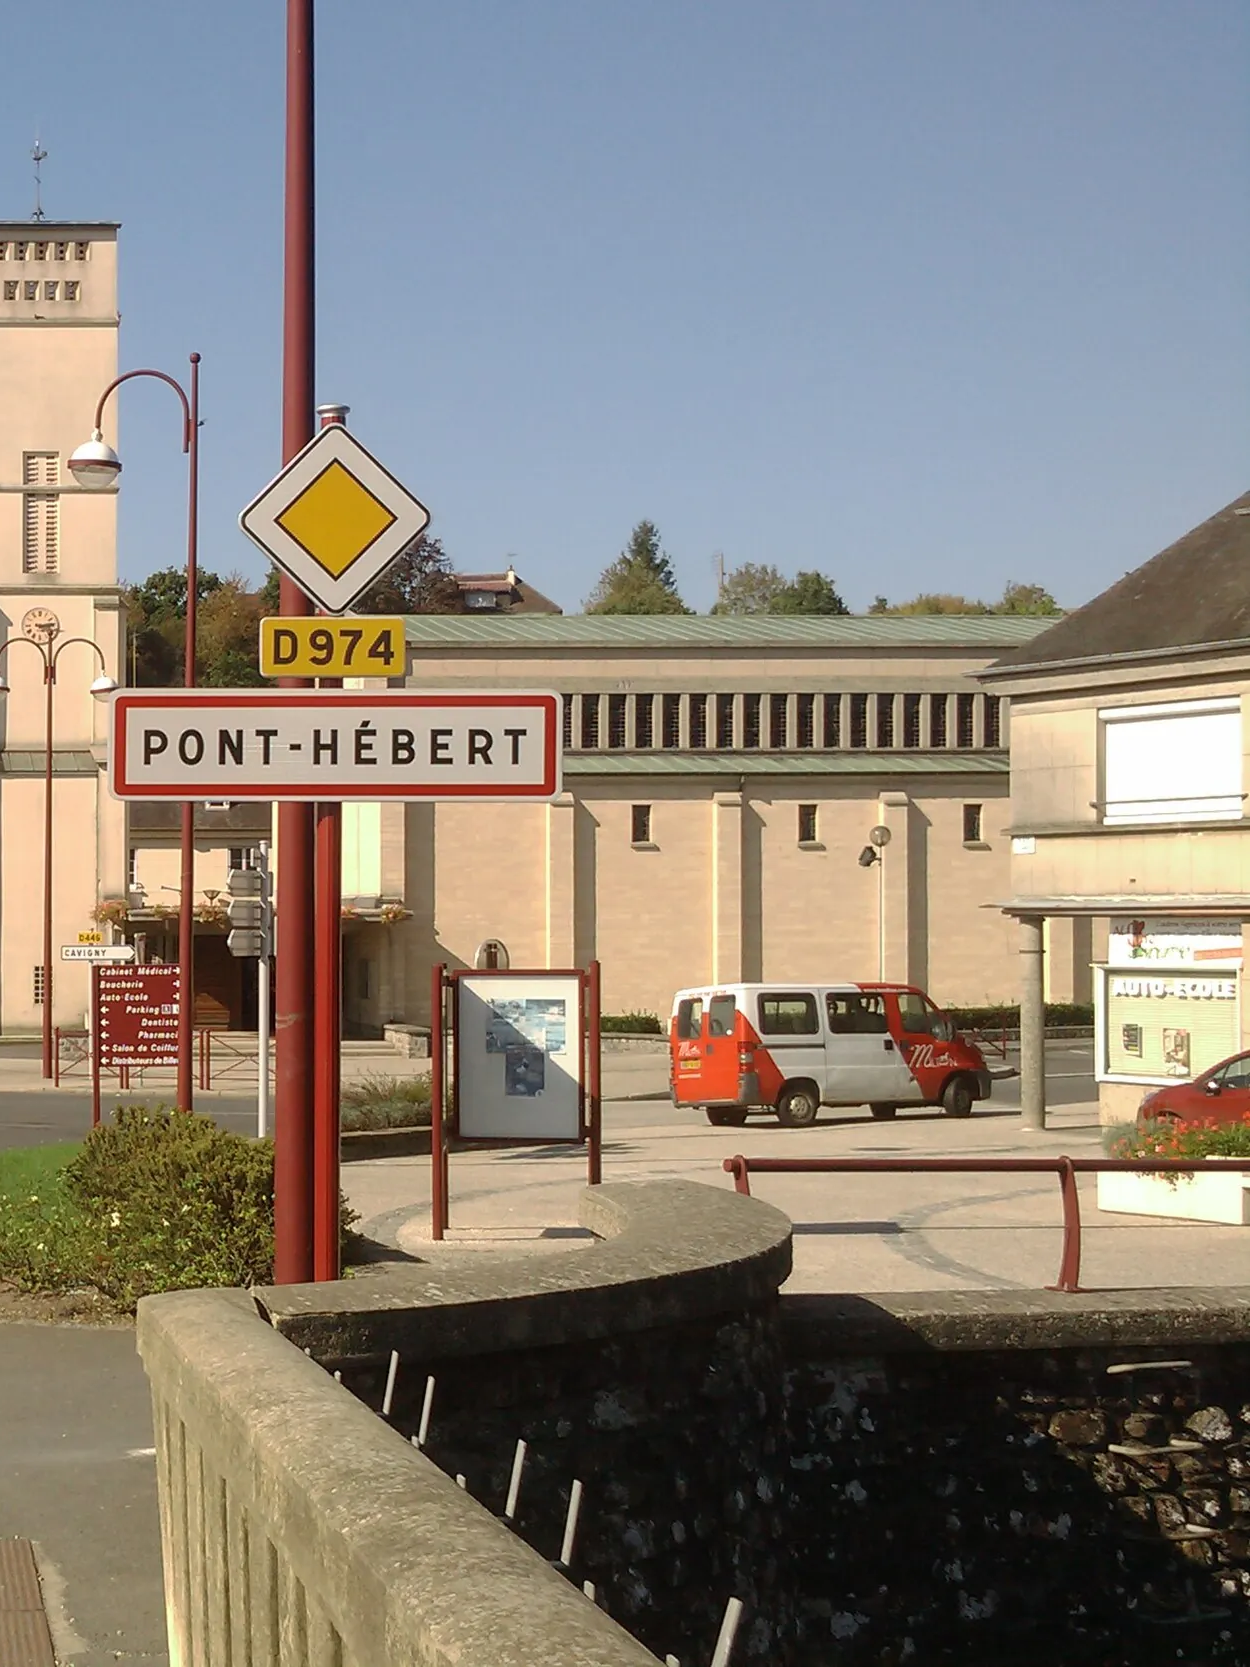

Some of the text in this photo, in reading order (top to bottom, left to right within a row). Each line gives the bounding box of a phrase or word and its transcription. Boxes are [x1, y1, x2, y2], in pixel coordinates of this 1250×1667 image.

[143, 720, 528, 766] PONT-HÉBERT
[100, 967, 171, 976] Cabinet Médical
[100, 980, 144, 988] Boucherie
[126, 1006, 160, 1015] Parking
[141, 1018, 179, 1026] Dentiste
[138, 1031, 179, 1039] Pharmaci
[112, 1044, 179, 1052] Salon de Coiffur
